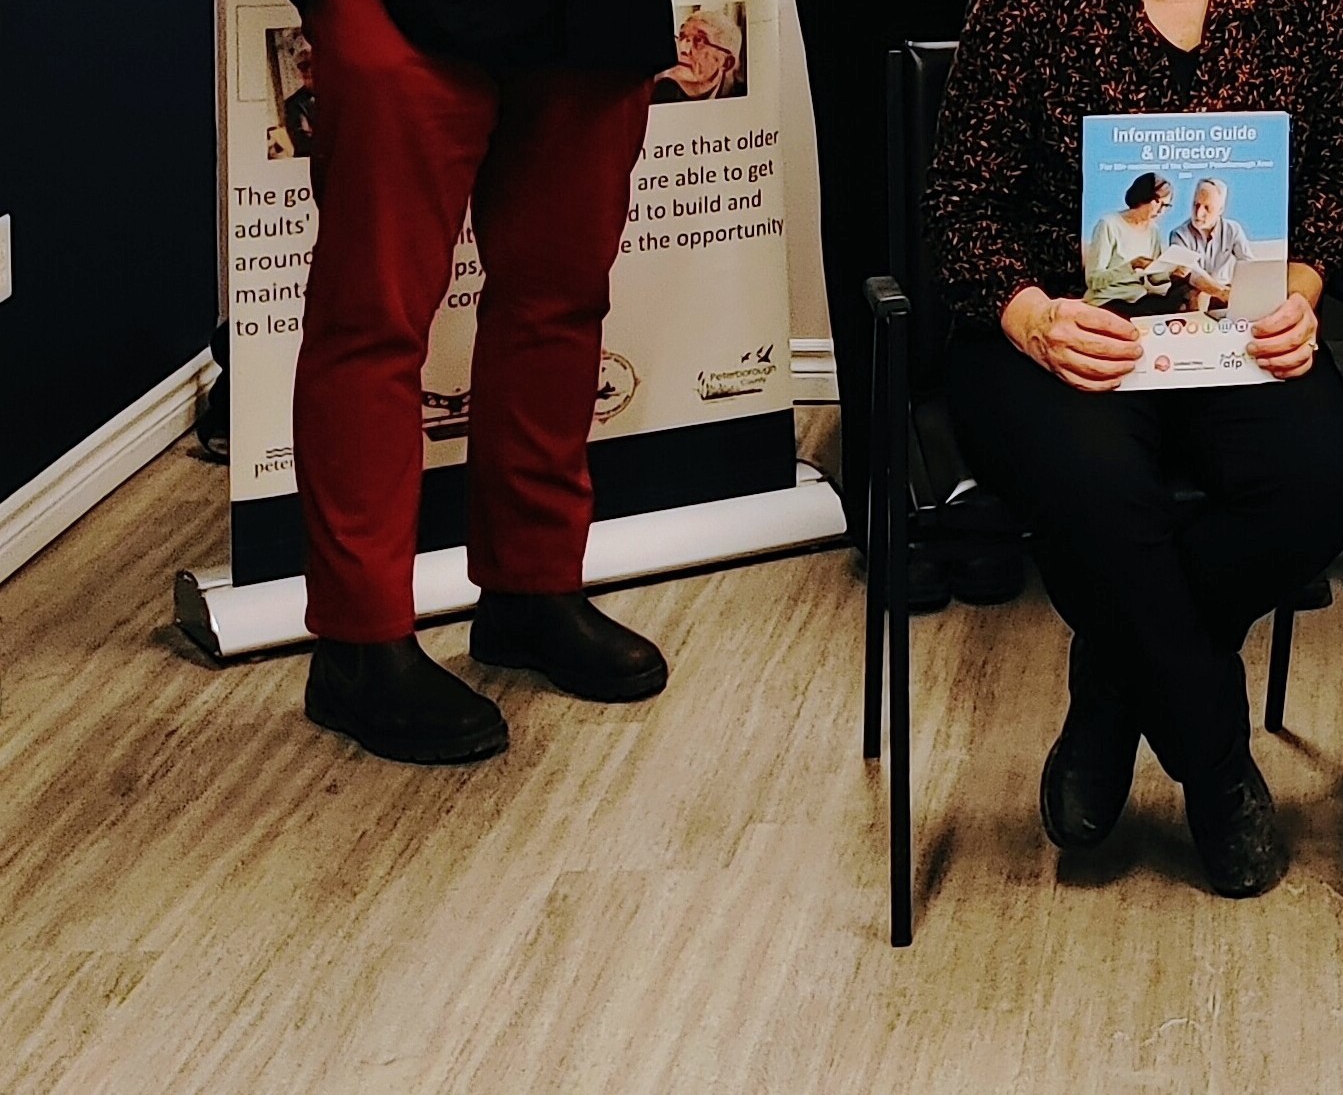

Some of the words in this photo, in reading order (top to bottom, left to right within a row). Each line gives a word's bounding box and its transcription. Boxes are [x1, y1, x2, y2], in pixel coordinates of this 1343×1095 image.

[653, 143, 685, 160] are
[691, 135, 731, 155] that
[737, 128, 779, 150] older
[1113, 126, 1206, 144] Information
[1210, 125, 1258, 142] Guide
[1141, 145, 1154, 161] &
[1158, 144, 1233, 163] Directory
[637, 174, 669, 191] are
[675, 166, 717, 187] able
[723, 165, 743, 182] to
[748, 159, 774, 183] get
[233, 186, 277, 206] The
[647, 204, 666, 221] to
[673, 194, 721, 217] build
[727, 189, 762, 211] and
[234, 213, 310, 239] adults'
[638, 232, 670, 252] the
[676, 217, 784, 250] opportunity
[235, 281, 307, 304] maint
[236, 319, 259, 337] to
[267, 315, 299, 335] lea
